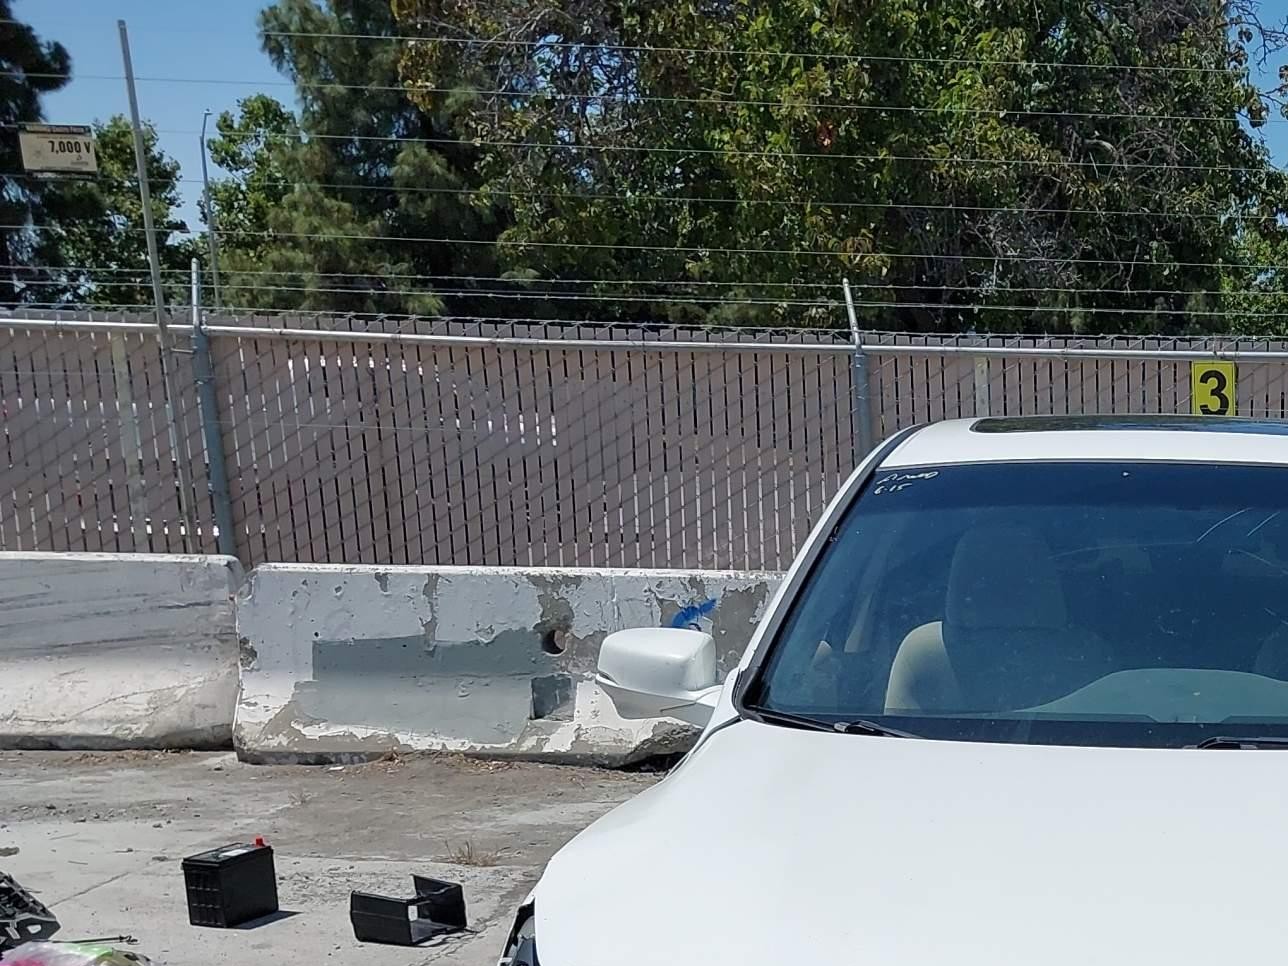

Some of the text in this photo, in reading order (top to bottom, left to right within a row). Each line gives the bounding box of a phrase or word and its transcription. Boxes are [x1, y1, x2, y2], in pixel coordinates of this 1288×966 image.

[48, 140, 91, 154] 7,000 V
[1199, 369, 1229, 415] 3
